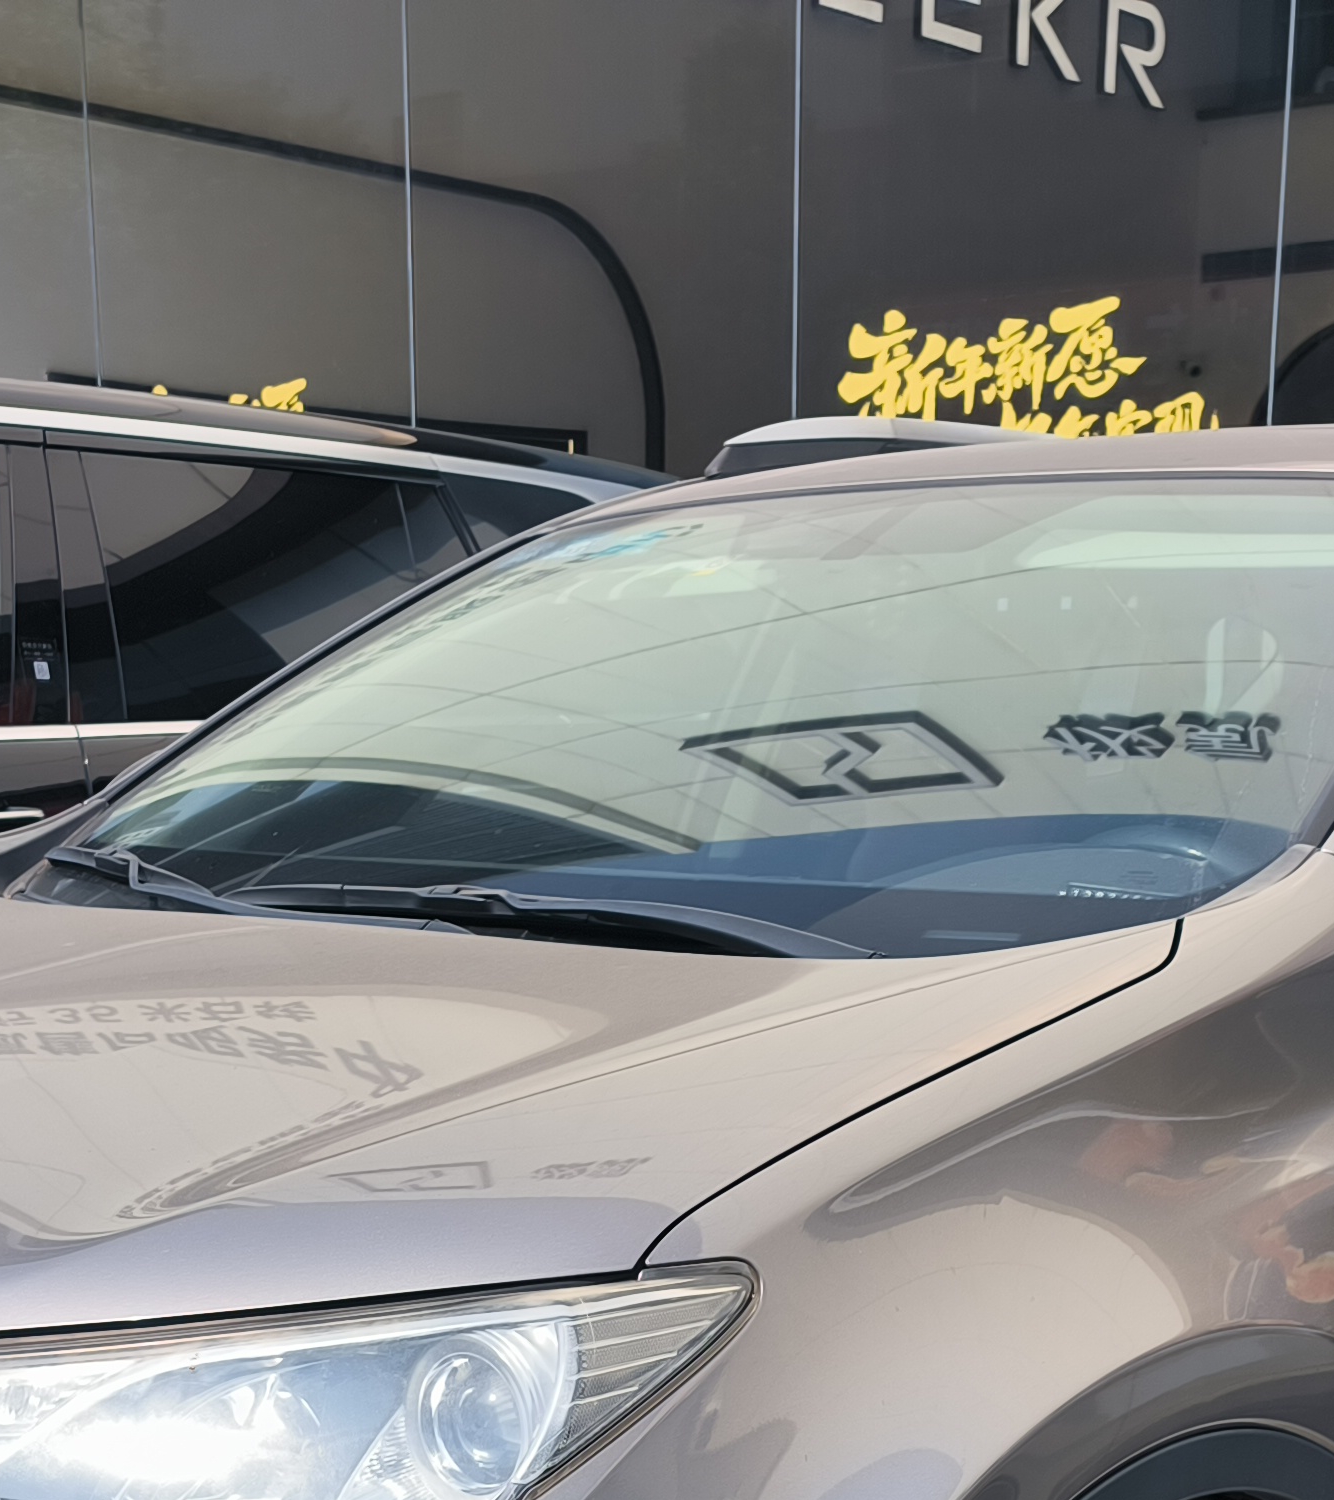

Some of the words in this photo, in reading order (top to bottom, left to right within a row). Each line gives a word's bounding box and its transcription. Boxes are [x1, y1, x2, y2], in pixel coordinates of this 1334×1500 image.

[817, 0, 1166, 109] KR
[837, 296, 1148, 421] 新年新愿
